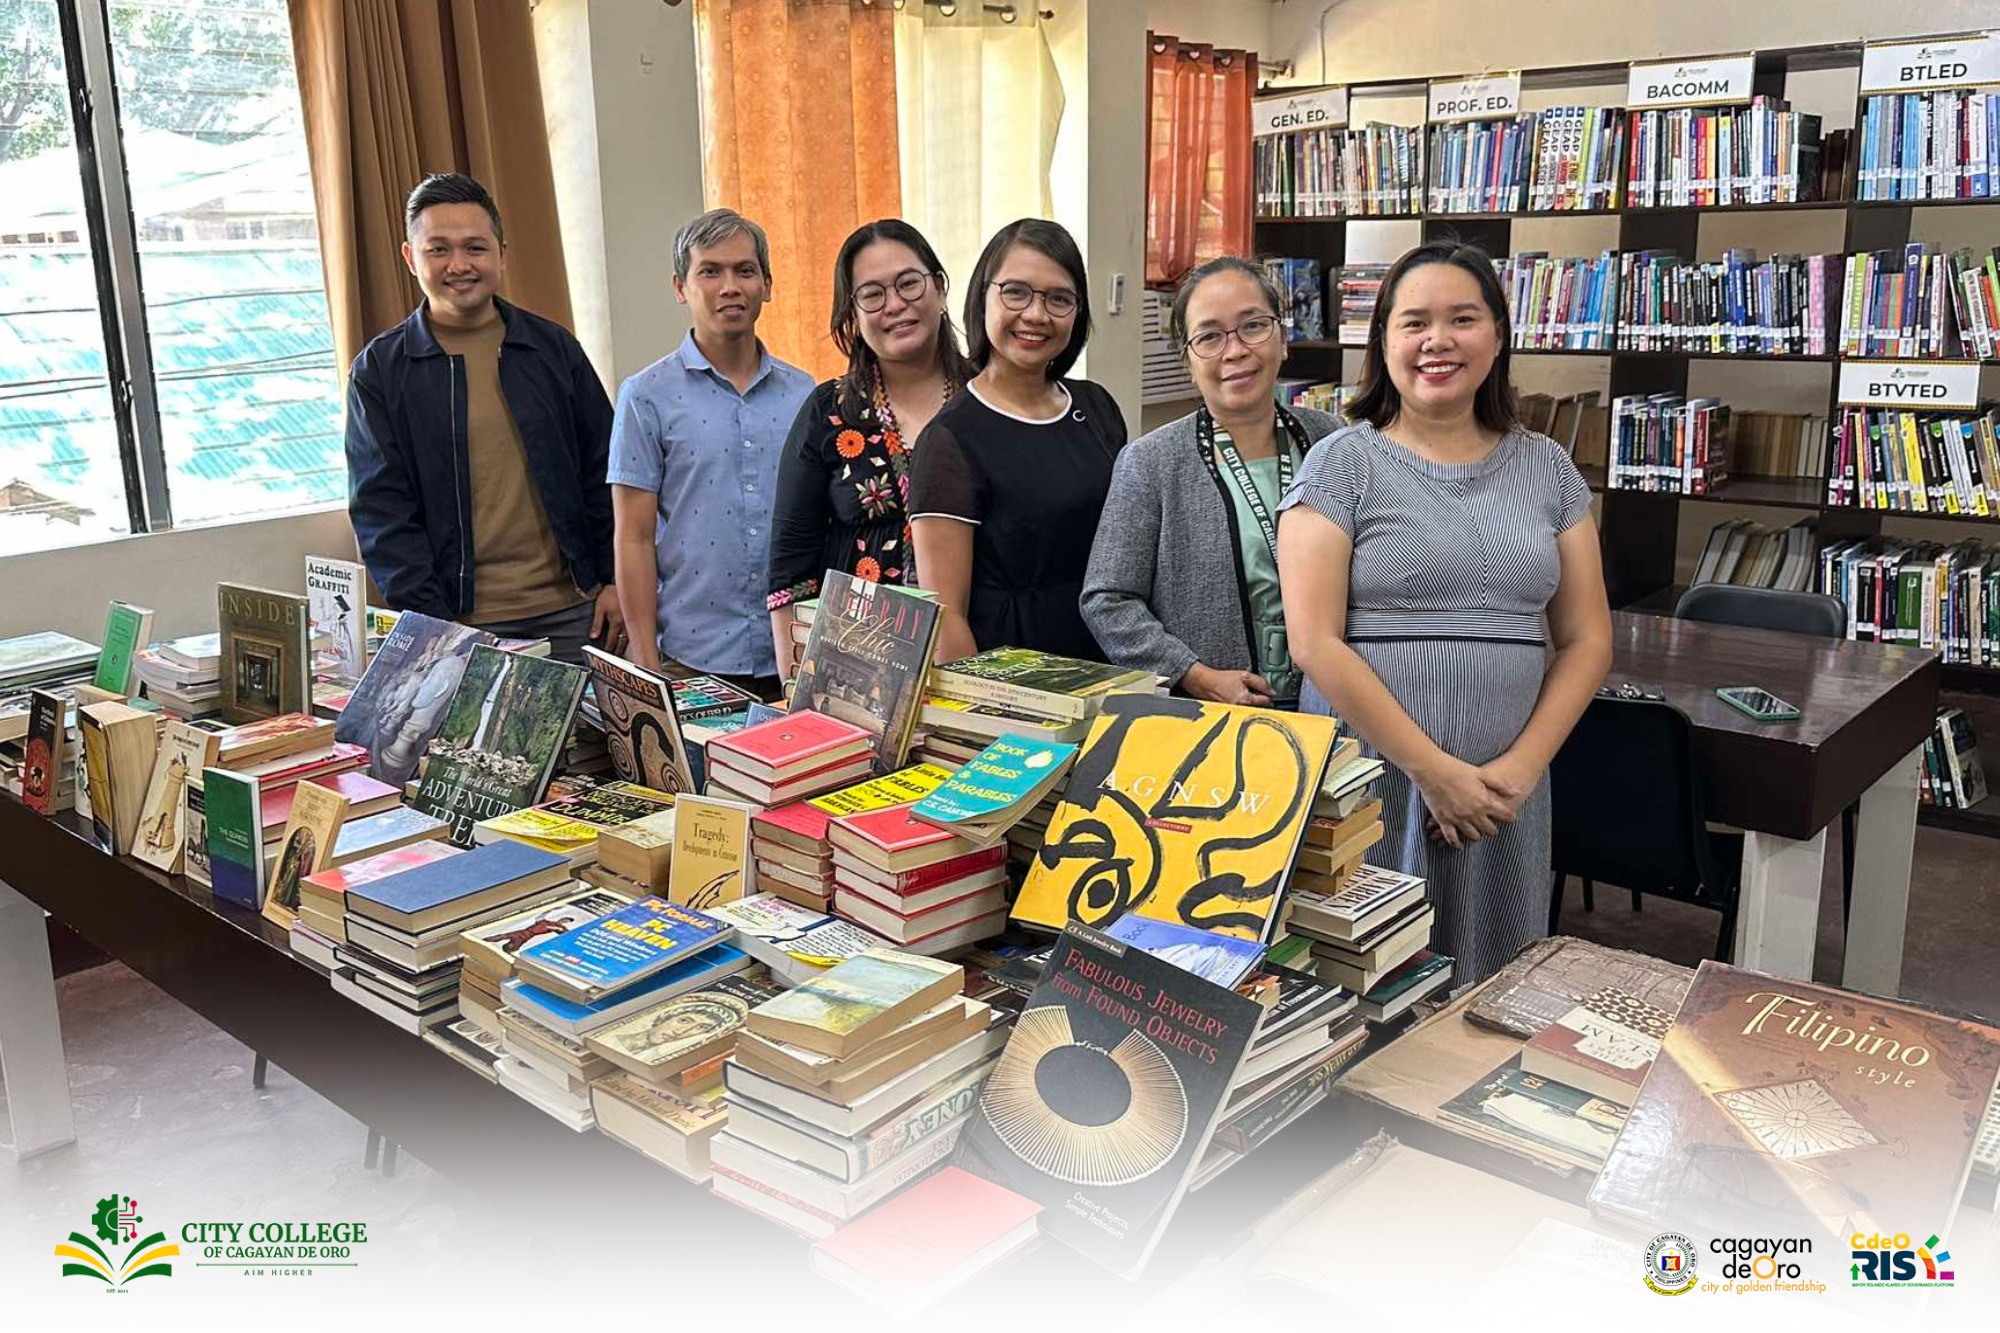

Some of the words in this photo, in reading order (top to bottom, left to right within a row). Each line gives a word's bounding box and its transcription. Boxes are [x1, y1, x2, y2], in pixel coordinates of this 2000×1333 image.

[1900, 63, 1968, 82] BTLED
[1647, 80, 1729, 98] BACOMM
[1437, 99, 1482, 115] PROF.
[1486, 96, 1512, 110] ED.
[1271, 113, 1303, 129] GEN.
[1307, 109, 1329, 123] ED.
[1869, 382, 1947, 399] BTVTED
[1222, 446, 1240, 469] CITY
[1234, 466, 1258, 506] COLLEGE
[1253, 504, 1267, 520] OF
[1260, 519, 1278, 562] CAGA
[307, 562, 352, 581] Academic
[308, 576, 349, 594] GRAFFITI
[219, 591, 296, 626] INSIDE
[982, 752, 1001, 761] OF
[993, 742, 1029, 757] BOOK
[693, 822, 729, 845] Tragedy:
[601, 918, 679, 951] HEAVEN
[642, 918, 673, 934] PC
[1065, 948, 1146, 1001] FABULOUS
[1147, 989, 1228, 1039] JEWELRY
[1050, 971, 1082, 999] from
[1086, 986, 1141, 1026] FOUND
[1146, 1015, 1219, 1065] OBJECTS
[1740, 991, 1932, 1068] Filipino
[1855, 1064, 1917, 1089] style
